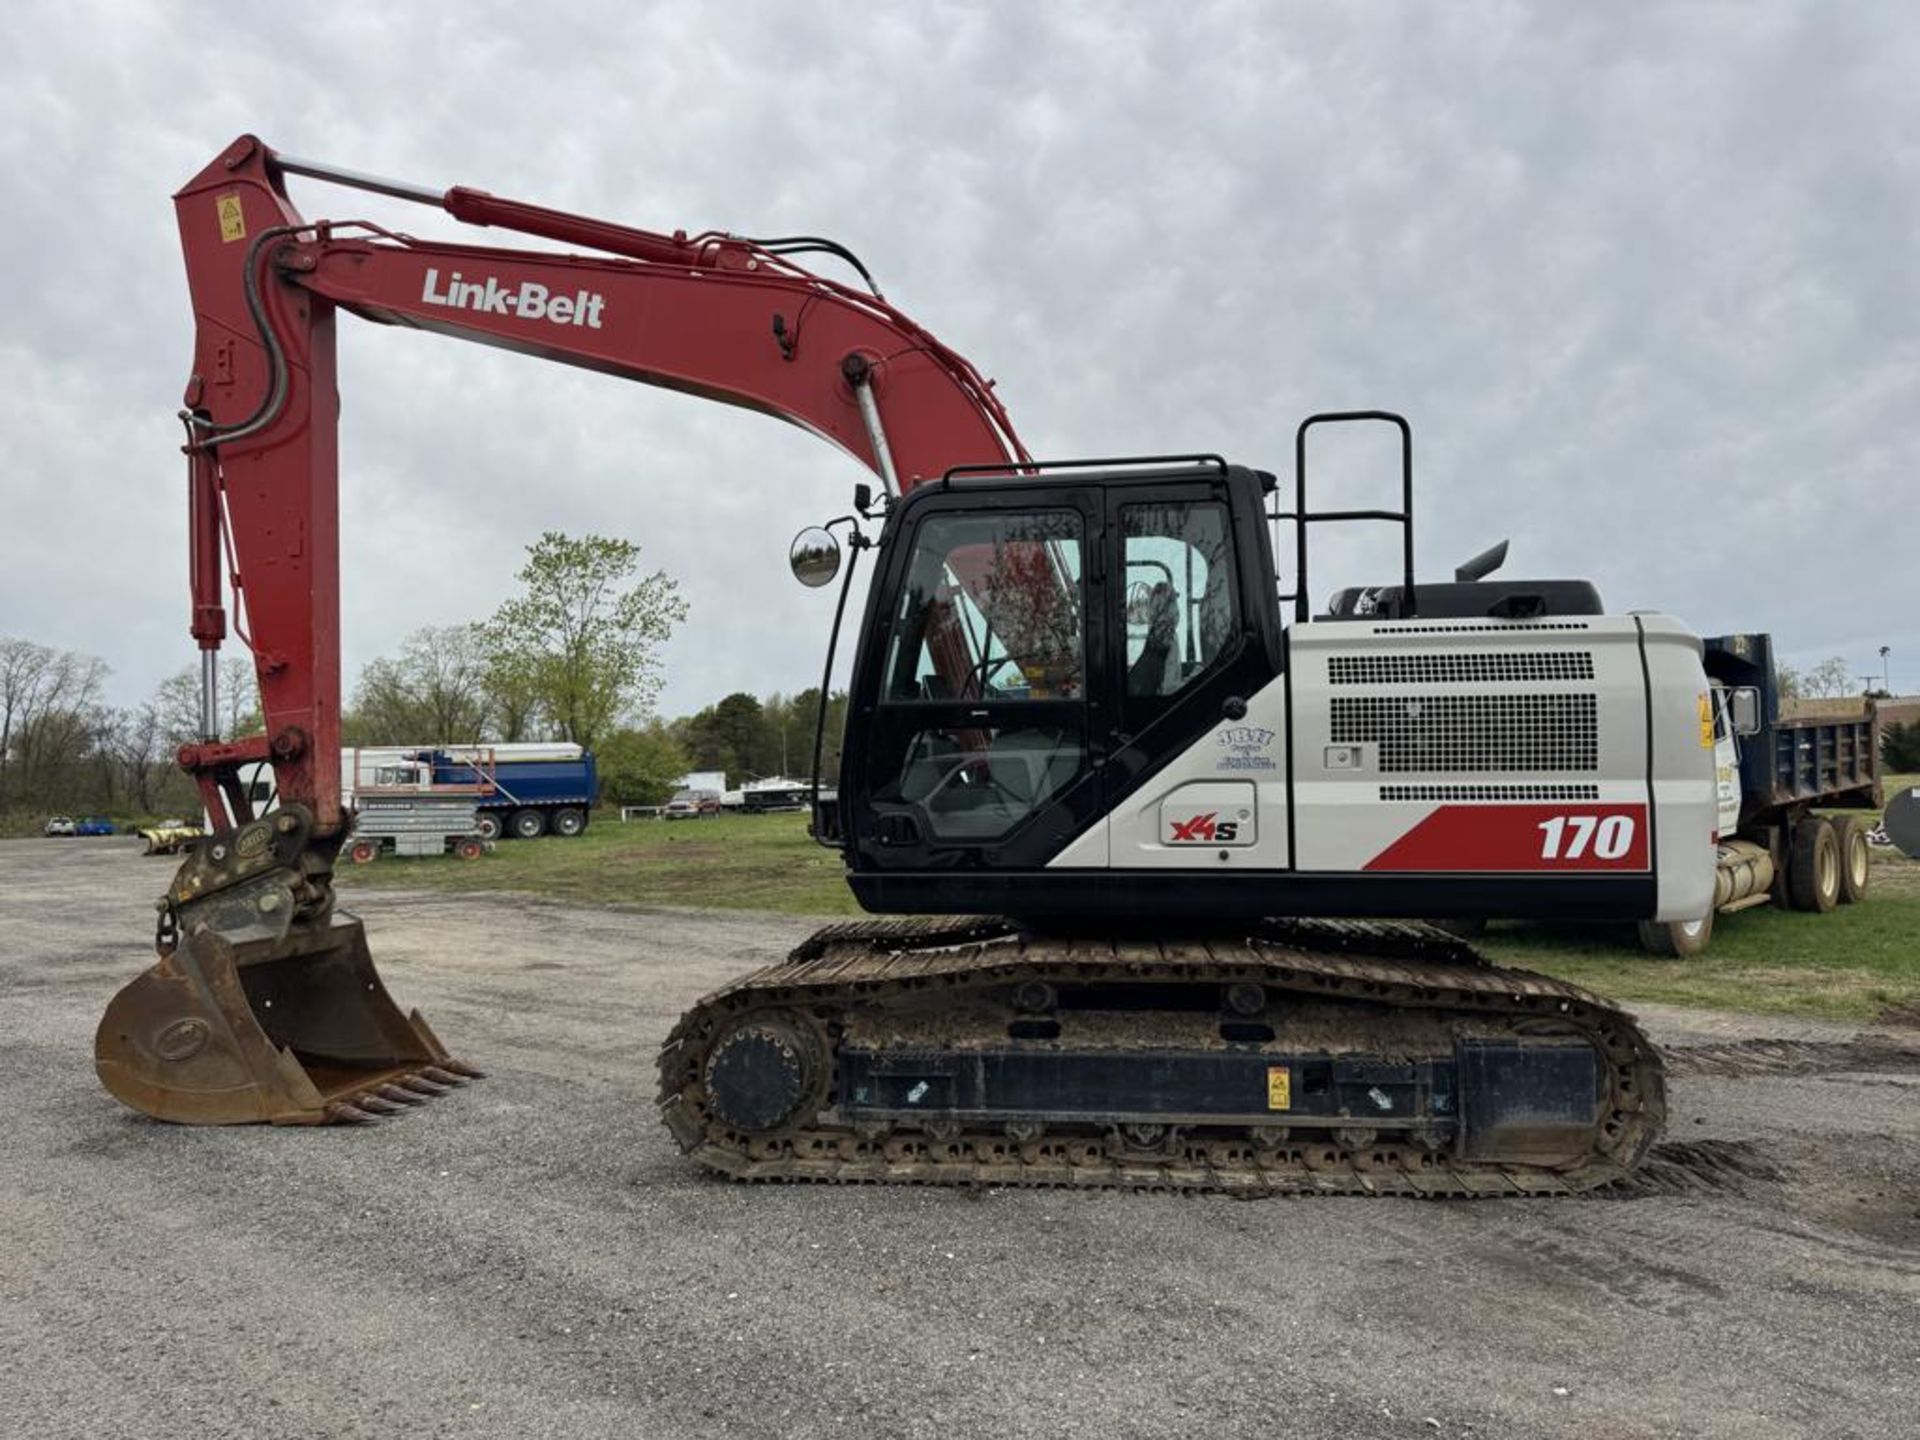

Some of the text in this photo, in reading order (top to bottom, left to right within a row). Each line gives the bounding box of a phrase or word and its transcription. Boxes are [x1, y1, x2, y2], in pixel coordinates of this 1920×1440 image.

[422, 268, 604, 328] Link-Belt
[1170, 812, 1238, 840] X4S
[1538, 815, 1635, 859] 170
